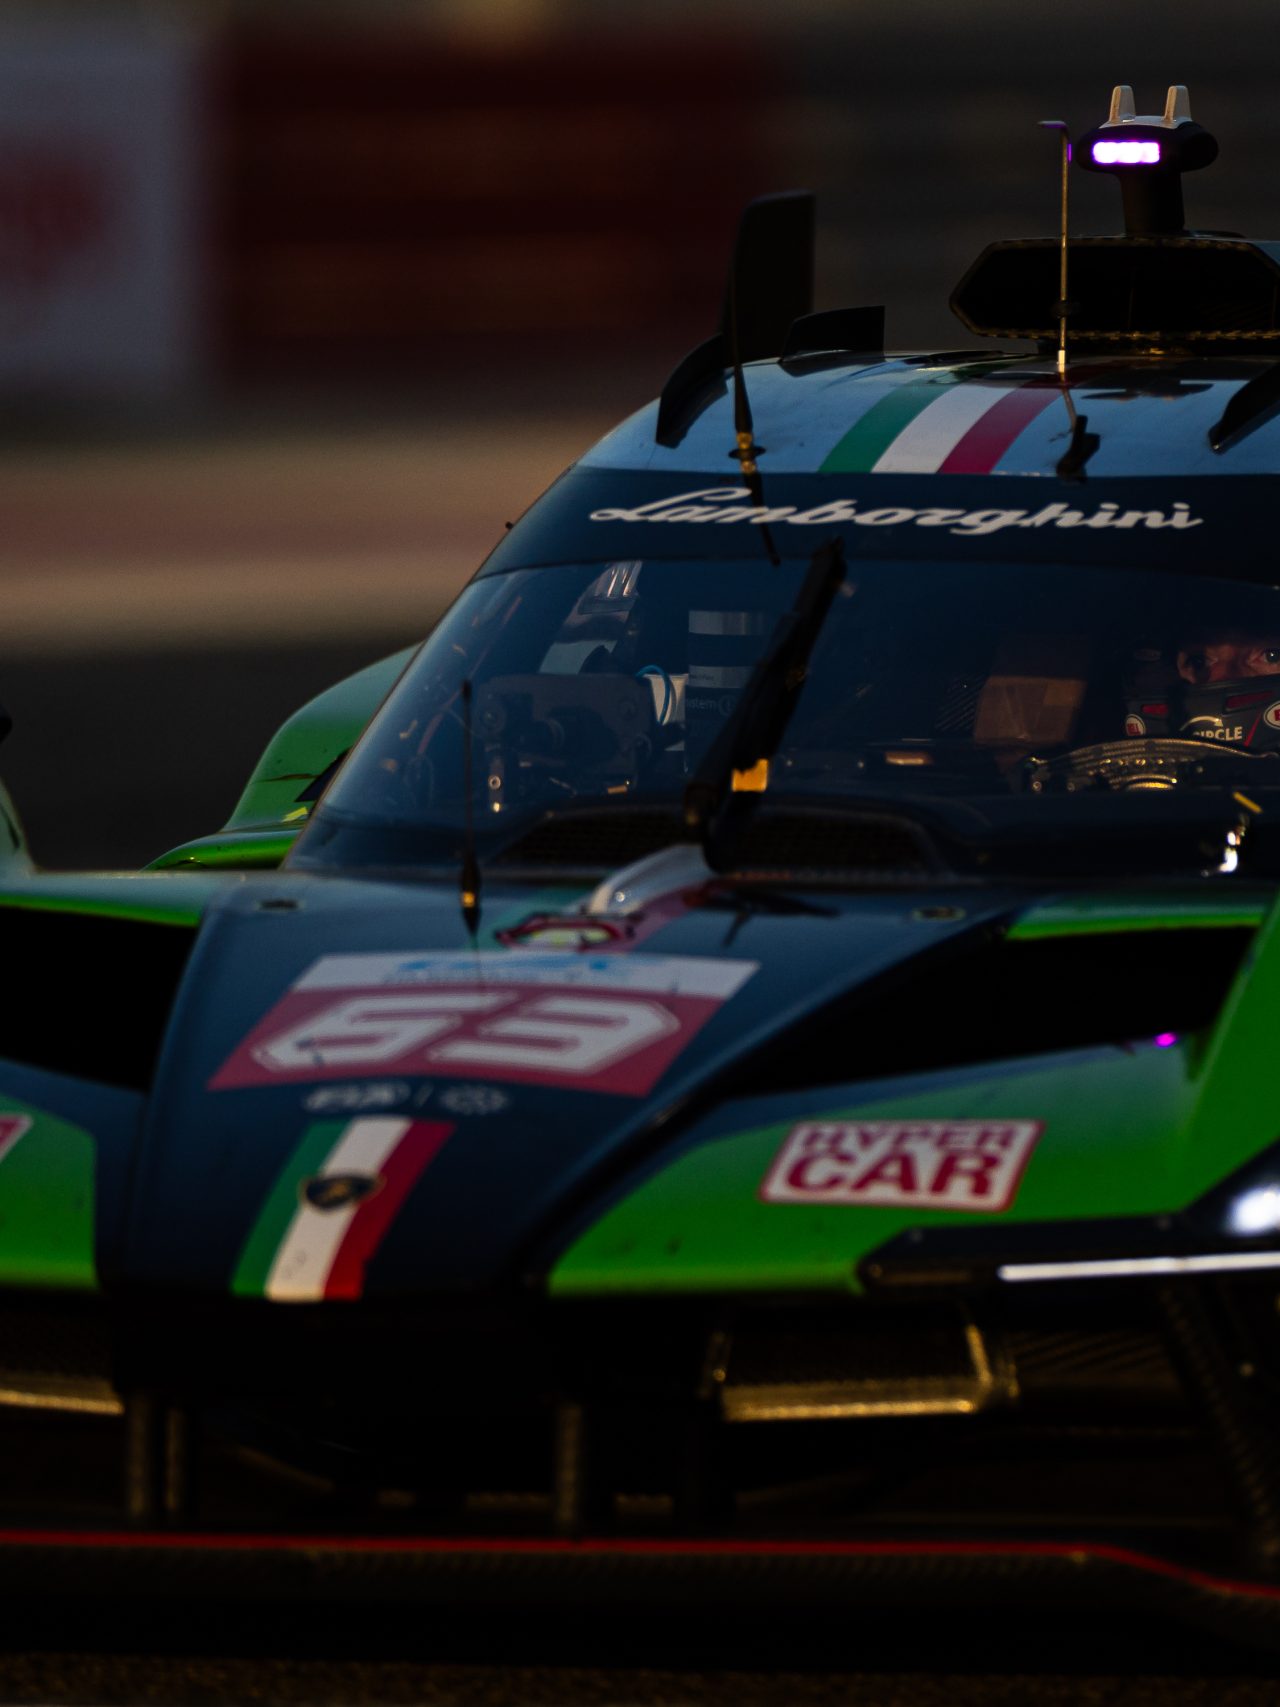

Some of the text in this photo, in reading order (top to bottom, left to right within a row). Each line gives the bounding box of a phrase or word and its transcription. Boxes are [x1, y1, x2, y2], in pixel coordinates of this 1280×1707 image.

[589, 486, 1204, 537] Lamborghini
[250, 992, 684, 1077] 53
[803, 1123, 1016, 1151] HYPER
[786, 1151, 1006, 1196] CAR
